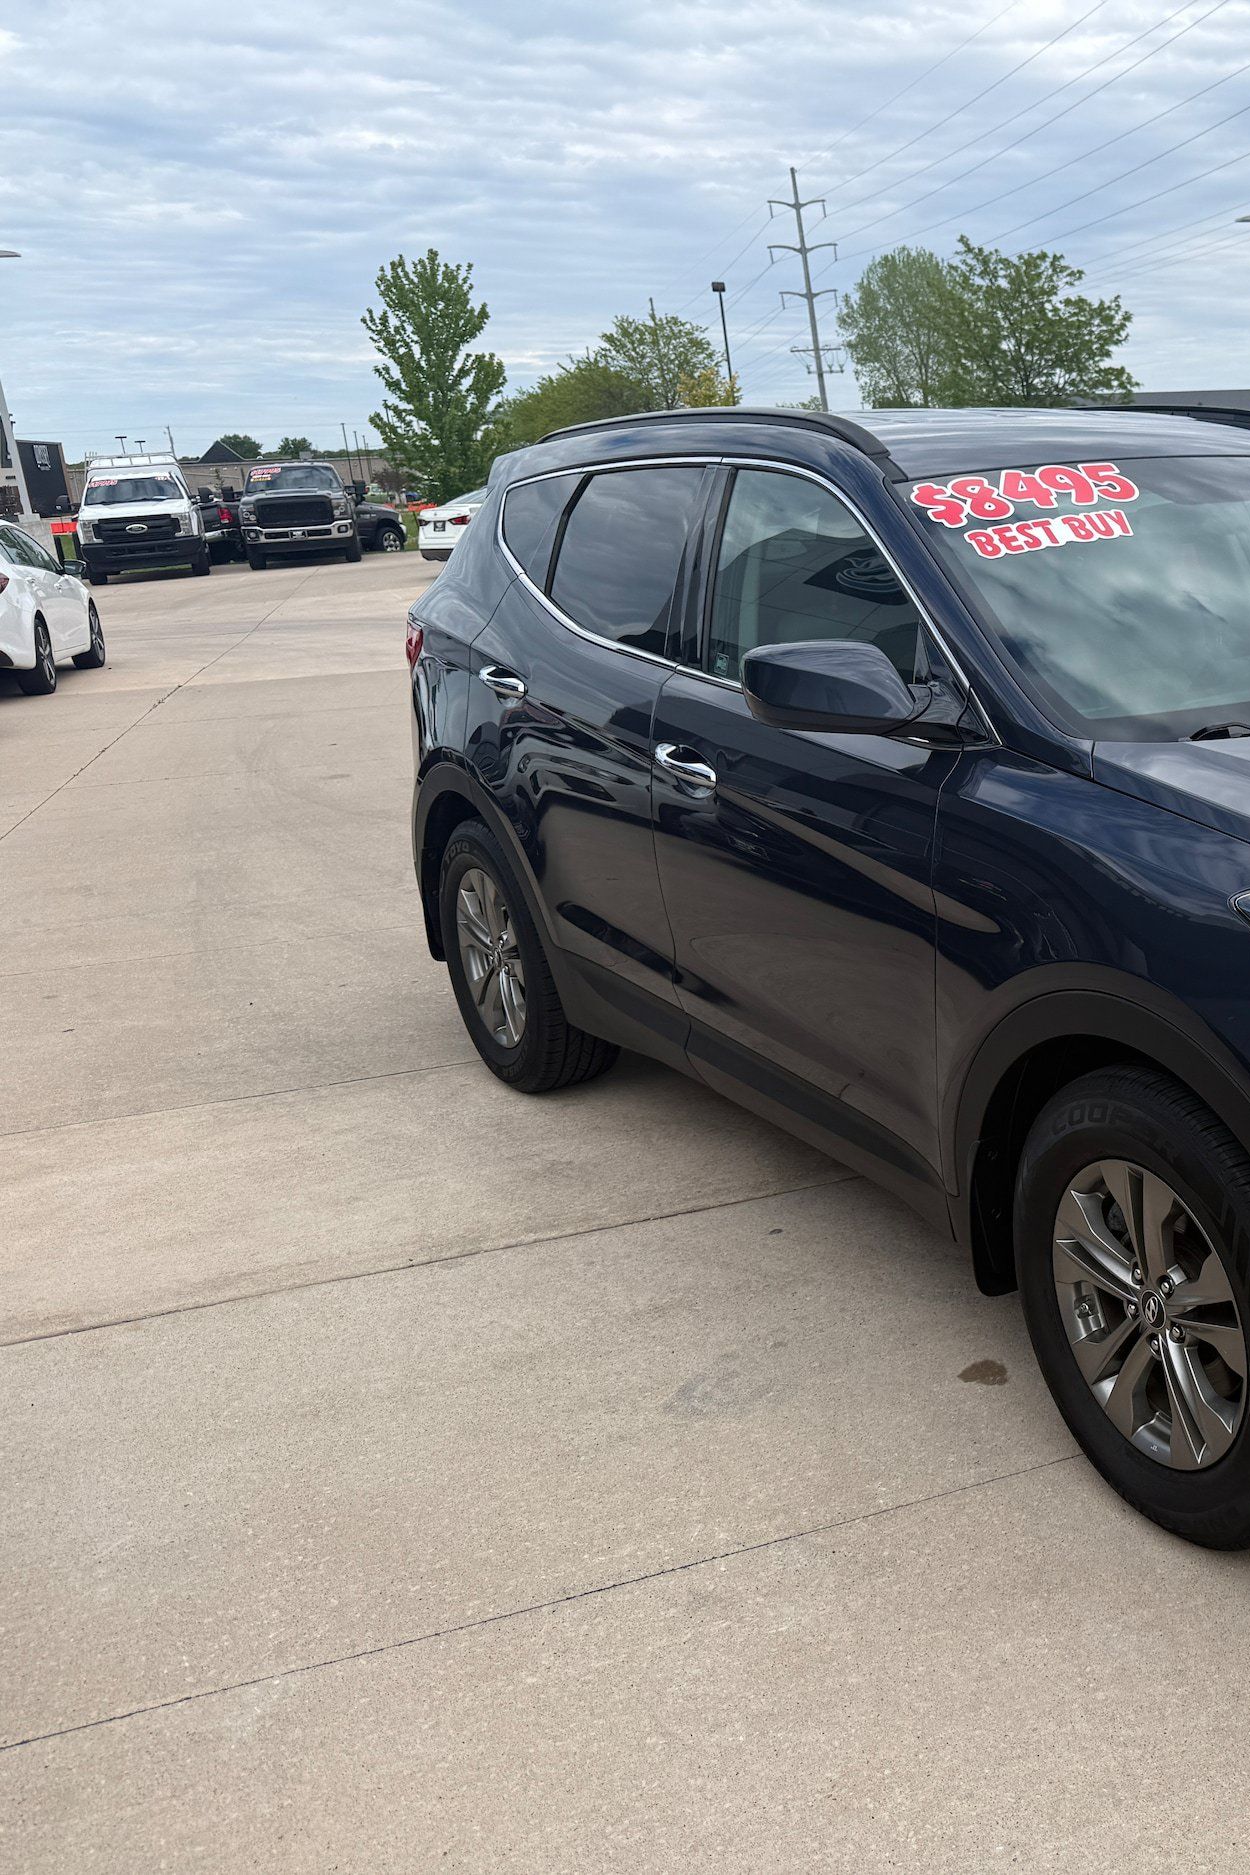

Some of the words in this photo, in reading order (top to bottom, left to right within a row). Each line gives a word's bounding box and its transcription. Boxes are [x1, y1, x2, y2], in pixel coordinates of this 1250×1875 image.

[911, 463, 1139, 528] $8495
[965, 519, 1060, 559] BEST
[1061, 510, 1134, 543] BUY
[444, 839, 470, 864] TOYO
